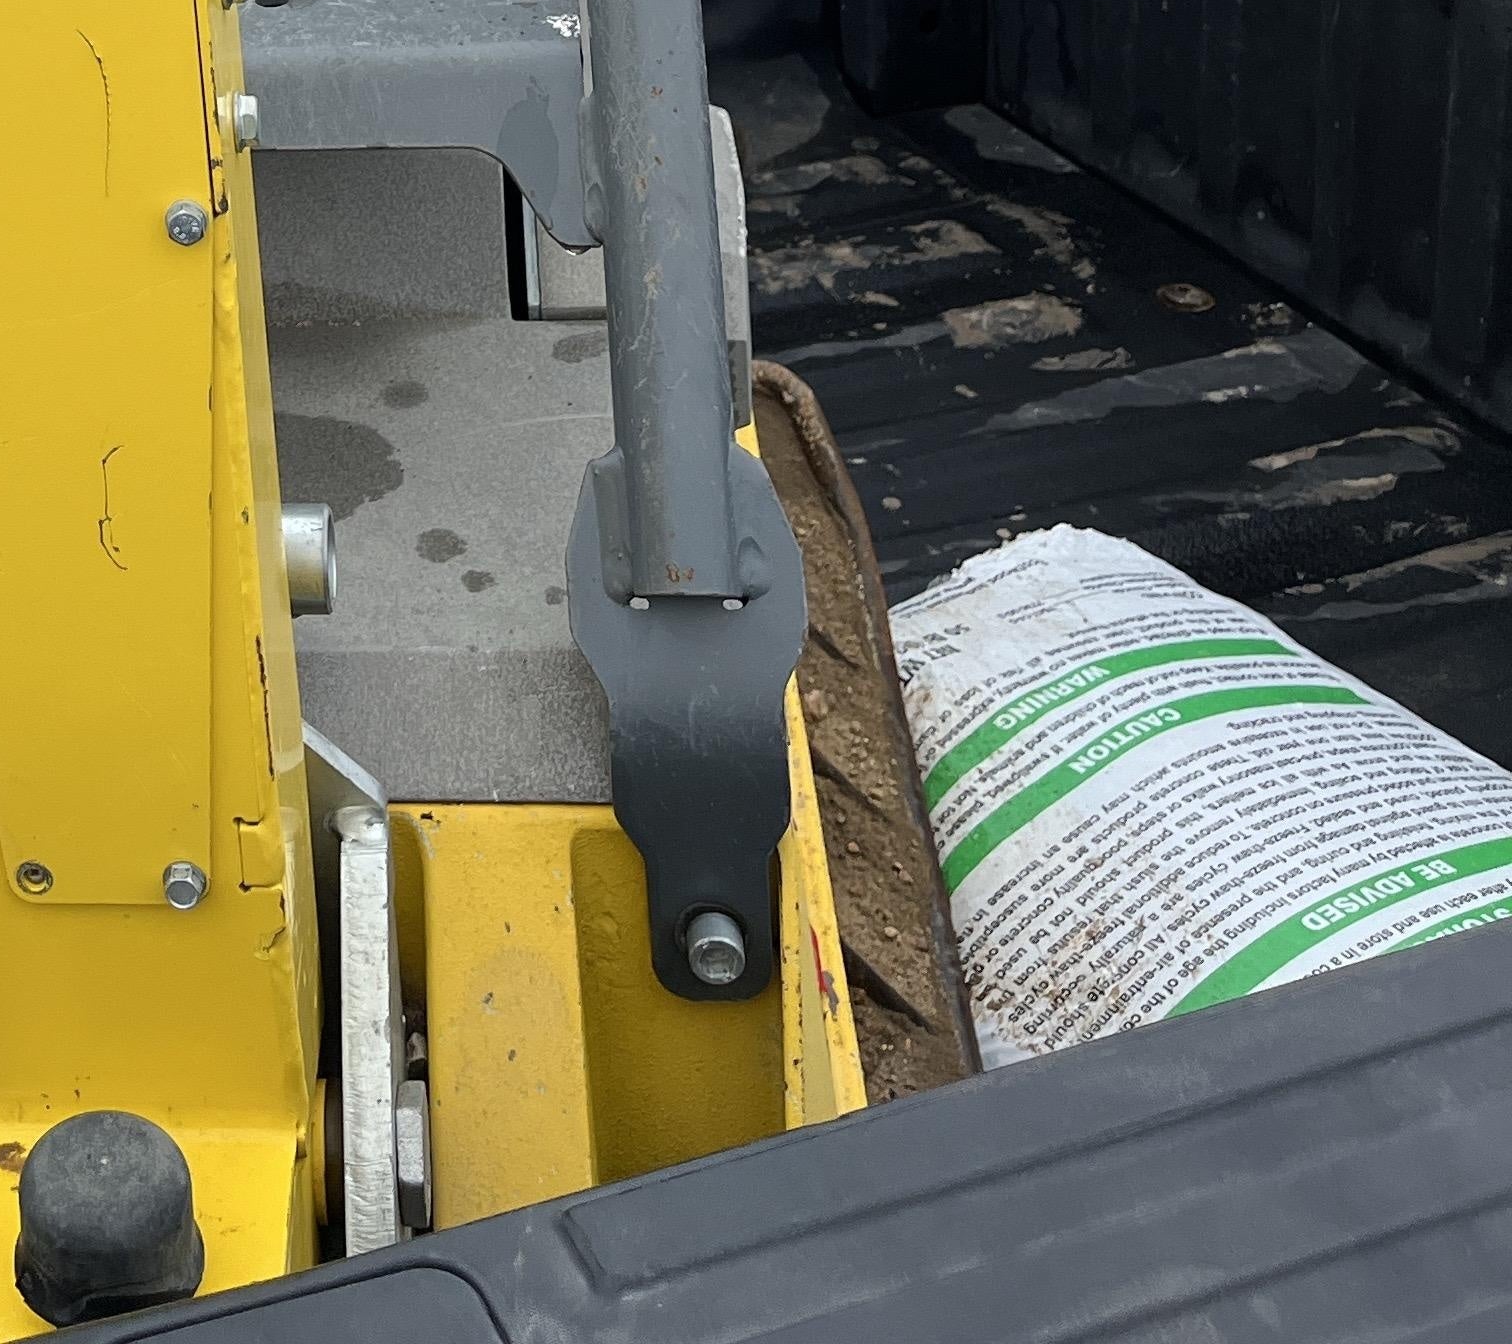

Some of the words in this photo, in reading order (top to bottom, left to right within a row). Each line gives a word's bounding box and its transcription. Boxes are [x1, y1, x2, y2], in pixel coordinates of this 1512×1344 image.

[994, 666, 1108, 728] WARNING
[1024, 730, 1048, 750] and
[1071, 708, 1179, 772] CAUTION
[1130, 767, 1169, 791] which
[1149, 770, 1204, 800] concrete
[1101, 792, 1129, 813] may
[1062, 814, 1100, 843] cause
[1091, 801, 1147, 843] products
[1175, 811, 1203, 828] this
[1185, 816, 1233, 844] remove
[1229, 827, 1250, 841] To
[1231, 824, 1309, 862] Freeze-thaw
[1349, 837, 1376, 851] and
[1042, 844, 1060, 858] an
[1067, 845, 1088, 862] are
[1122, 828, 1172, 866] product
[1160, 845, 1185, 861] the
[1184, 839, 1230, 867] reduce
[1283, 838, 1318, 856] from
[1368, 849, 1391, 863] by
[1030, 864, 1064, 891] more
[1053, 859, 1098, 897] quality
[1122, 862, 1159, 890] slush
[1185, 863, 1227, 891] cycles
[1210, 855, 1286, 899] freeze-thaw
[1275, 867, 1303, 884] and
[1332, 859, 1370, 877] many
[1411, 859, 1456, 880] BE
[987, 860, 1042, 905] increase
[1076, 868, 1120, 906] should
[1122, 868, 1184, 918] additional
[1252, 881, 1278, 895] the
[1287, 874, 1336, 899] factors
[1093, 893, 1123, 919] that
[1160, 893, 1183, 910] are
[1302, 872, 1413, 929] ADVISED
[1418, 904, 1446, 917] use
[1444, 892, 1478, 908] each
[972, 908, 989, 921] in
[998, 897, 1053, 946] concrete
[1049, 907, 1073, 926] not
[1147, 912, 1159, 921] a
[1191, 893, 1251, 938] presence
[1223, 897, 1290, 939] including
[1392, 915, 1420, 933] and
[955, 895, 1027, 964] susceptible
[1029, 928, 1050, 944] be
[1047, 916, 1093, 954] results
[1356, 929, 1393, 950] store
[1049, 918, 1124, 983] freeze-thaw
[1088, 921, 1145, 972] naturally
[1143, 933, 1164, 951] All
[1174, 939, 1190, 954] of
[1202, 938, 1228, 956] the
[1340, 947, 1361, 959] in
[984, 947, 998, 962] or
[994, 947, 1026, 979] used
[1177, 955, 1204, 977] age
[1329, 956, 1341, 965] a
[1013, 957, 1047, 986] from
[1307, 964, 1331, 978] co
[1162, 978, 1178, 994] of
[1008, 980, 1050, 1022] cycles
[1023, 975, 1085, 1034] occurring
[1140, 992, 1165, 1013] the
[1044, 1002, 1090, 1049] should
